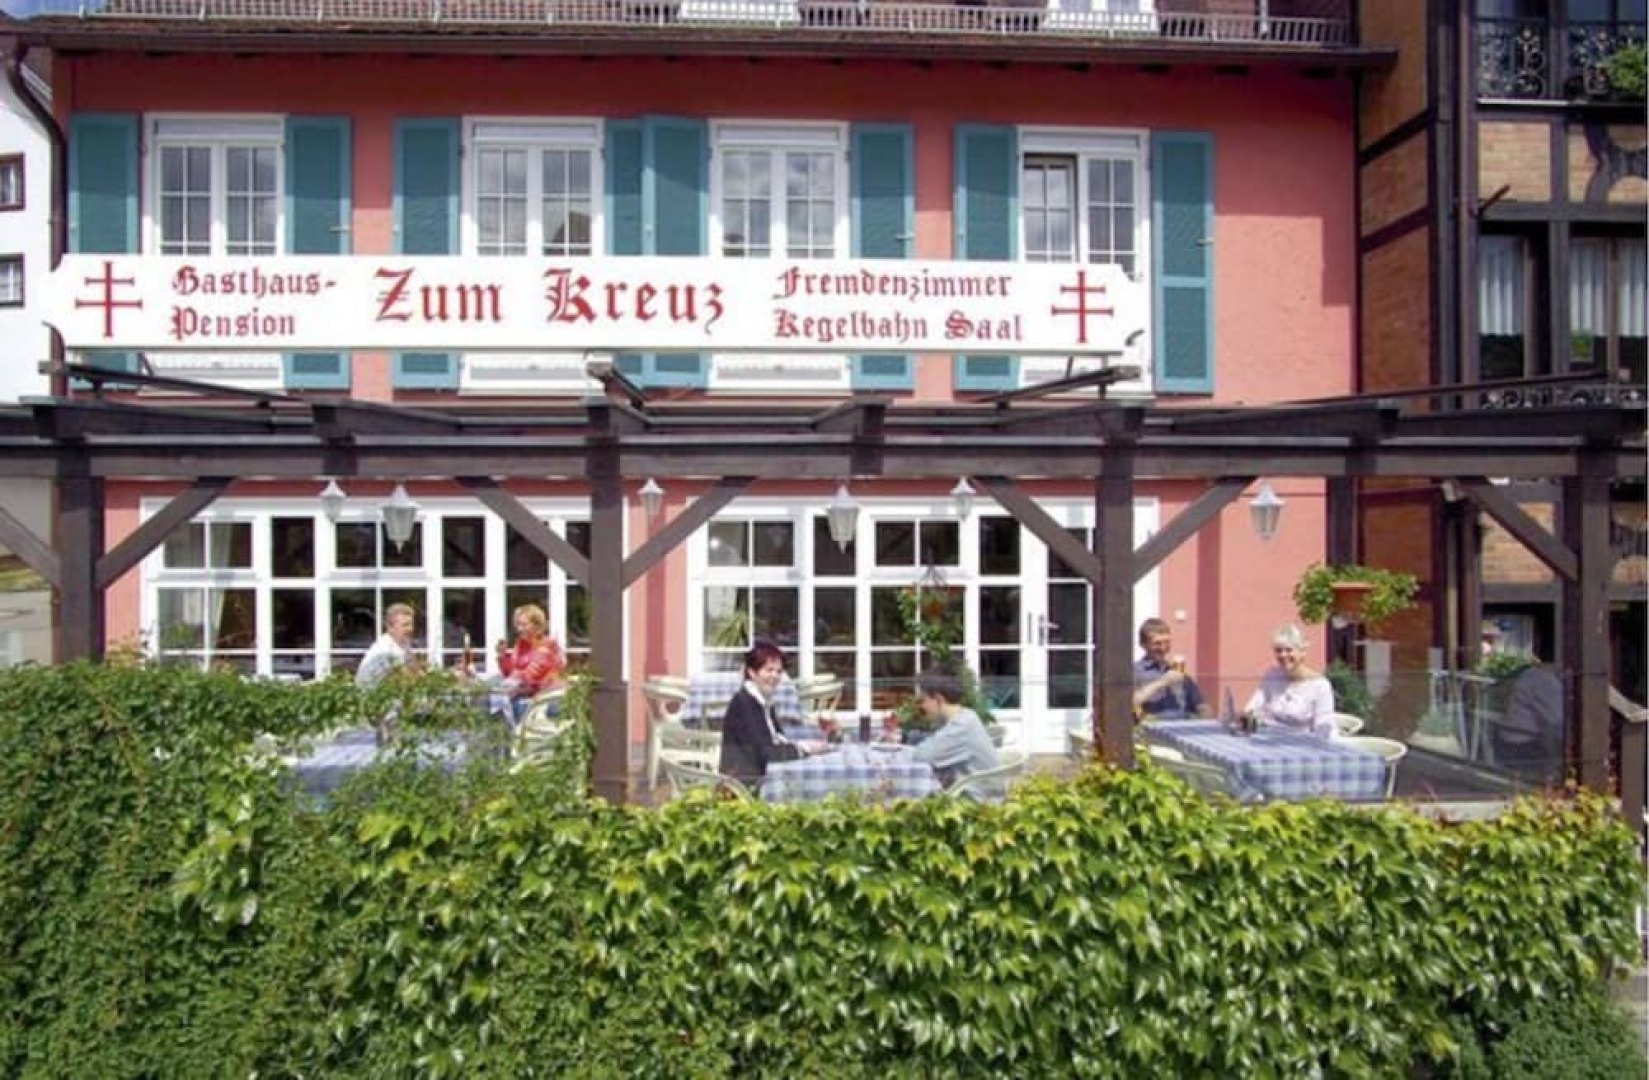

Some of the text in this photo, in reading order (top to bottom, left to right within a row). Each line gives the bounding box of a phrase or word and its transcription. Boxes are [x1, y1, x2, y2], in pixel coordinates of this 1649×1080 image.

[171, 265, 338, 297] Gasthaus-
[772, 266, 1013, 300] Fremdenzimmer
[375, 267, 725, 333] Zum Kreuz
[170, 307, 296, 341] Pension
[773, 308, 1024, 344] Kegelbahn Saal
